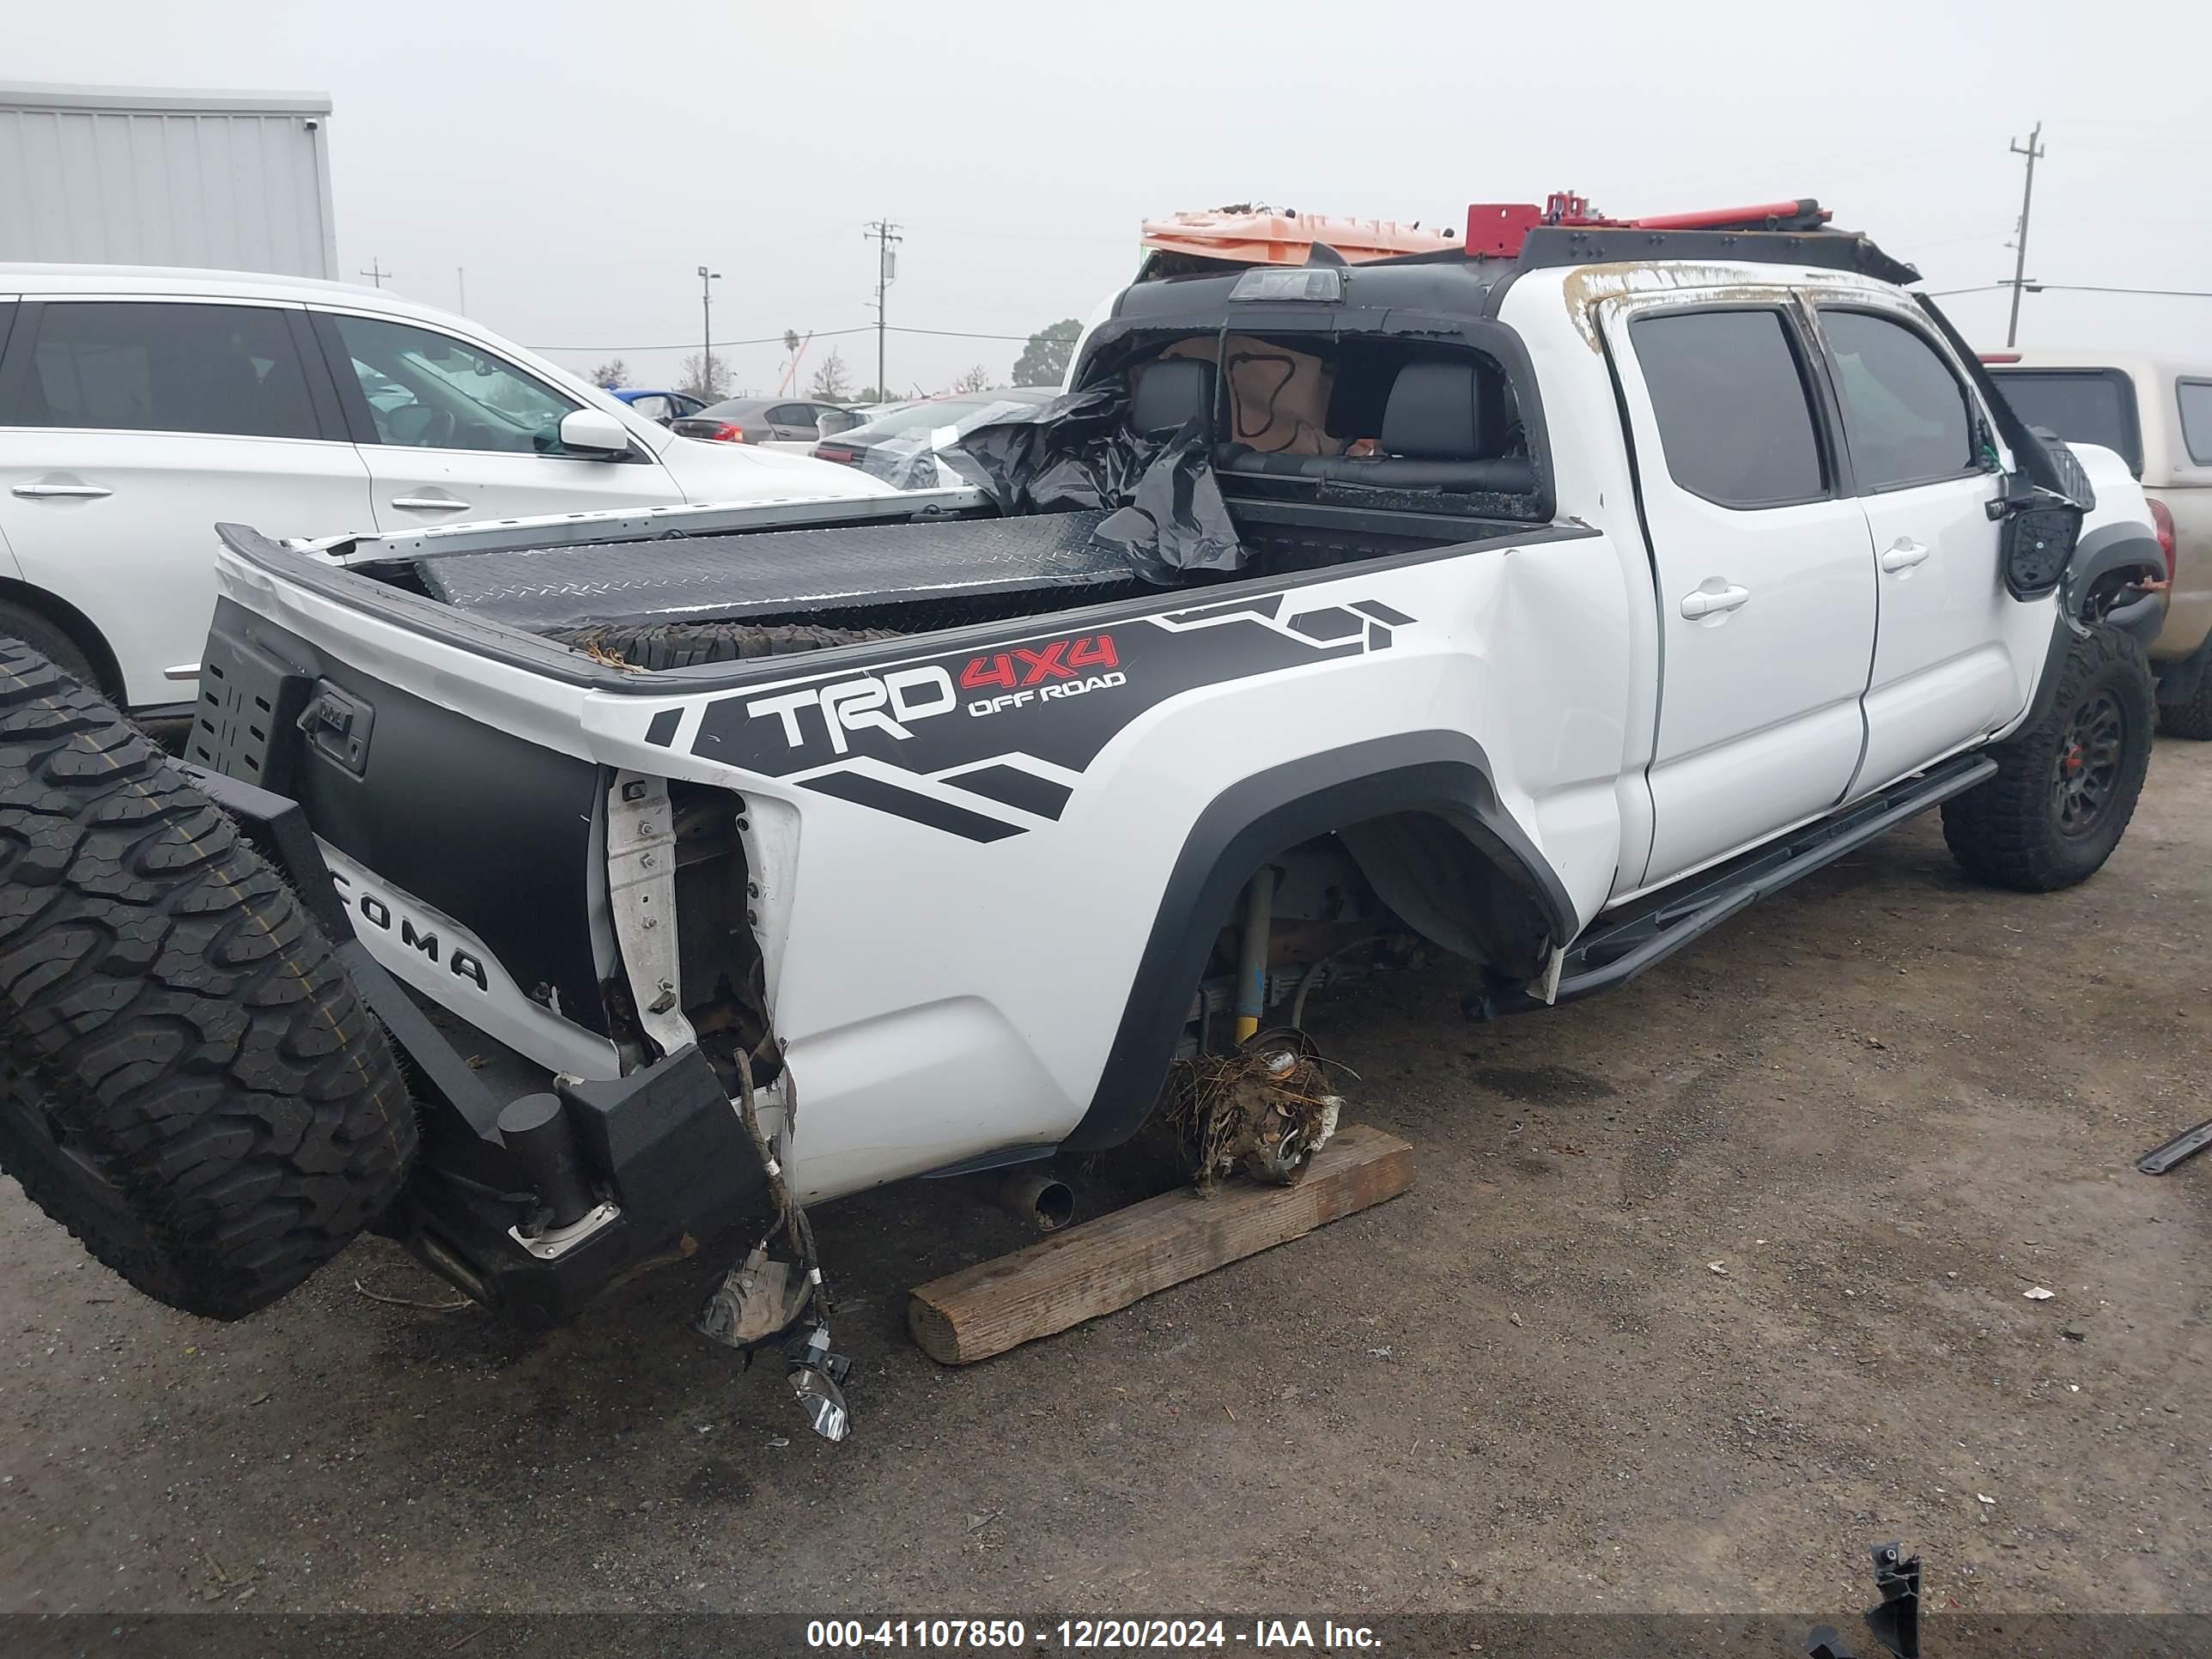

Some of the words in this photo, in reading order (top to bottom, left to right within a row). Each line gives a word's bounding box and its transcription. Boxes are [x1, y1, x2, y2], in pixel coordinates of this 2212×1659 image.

[746, 665, 957, 754] TRD
[968, 691, 1036, 718] OFF
[1038, 672, 1127, 702] ROAD
